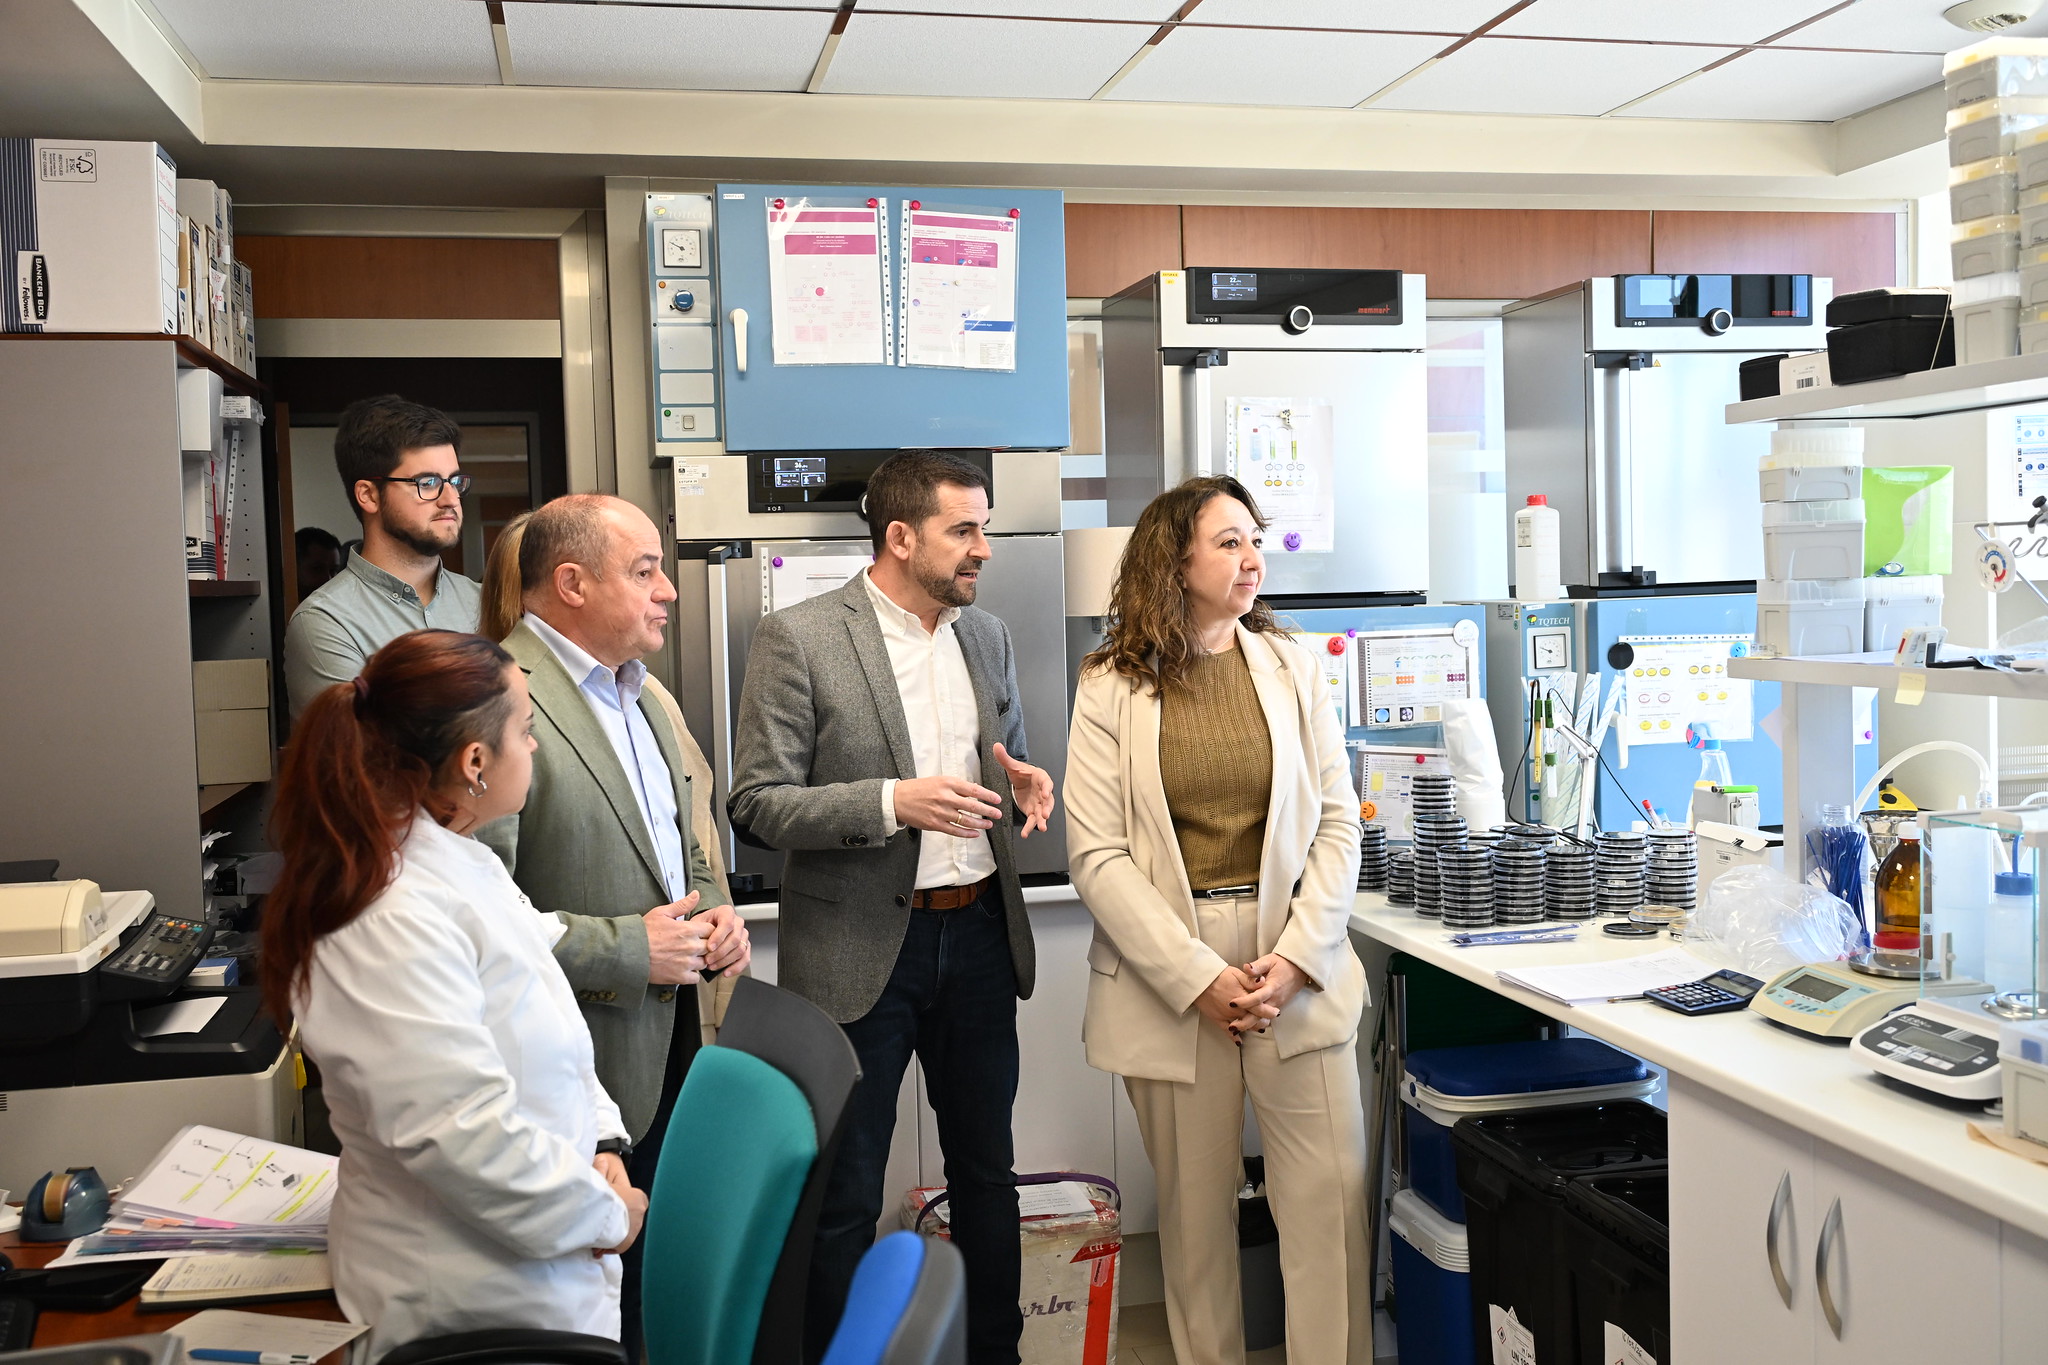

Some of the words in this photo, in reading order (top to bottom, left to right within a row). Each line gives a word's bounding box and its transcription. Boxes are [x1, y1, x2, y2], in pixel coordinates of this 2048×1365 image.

[1358, 304, 1390, 314] memmert
[1538, 617, 1570, 626] TQTECH
[1900, 1016, 1925, 1025] KERN
